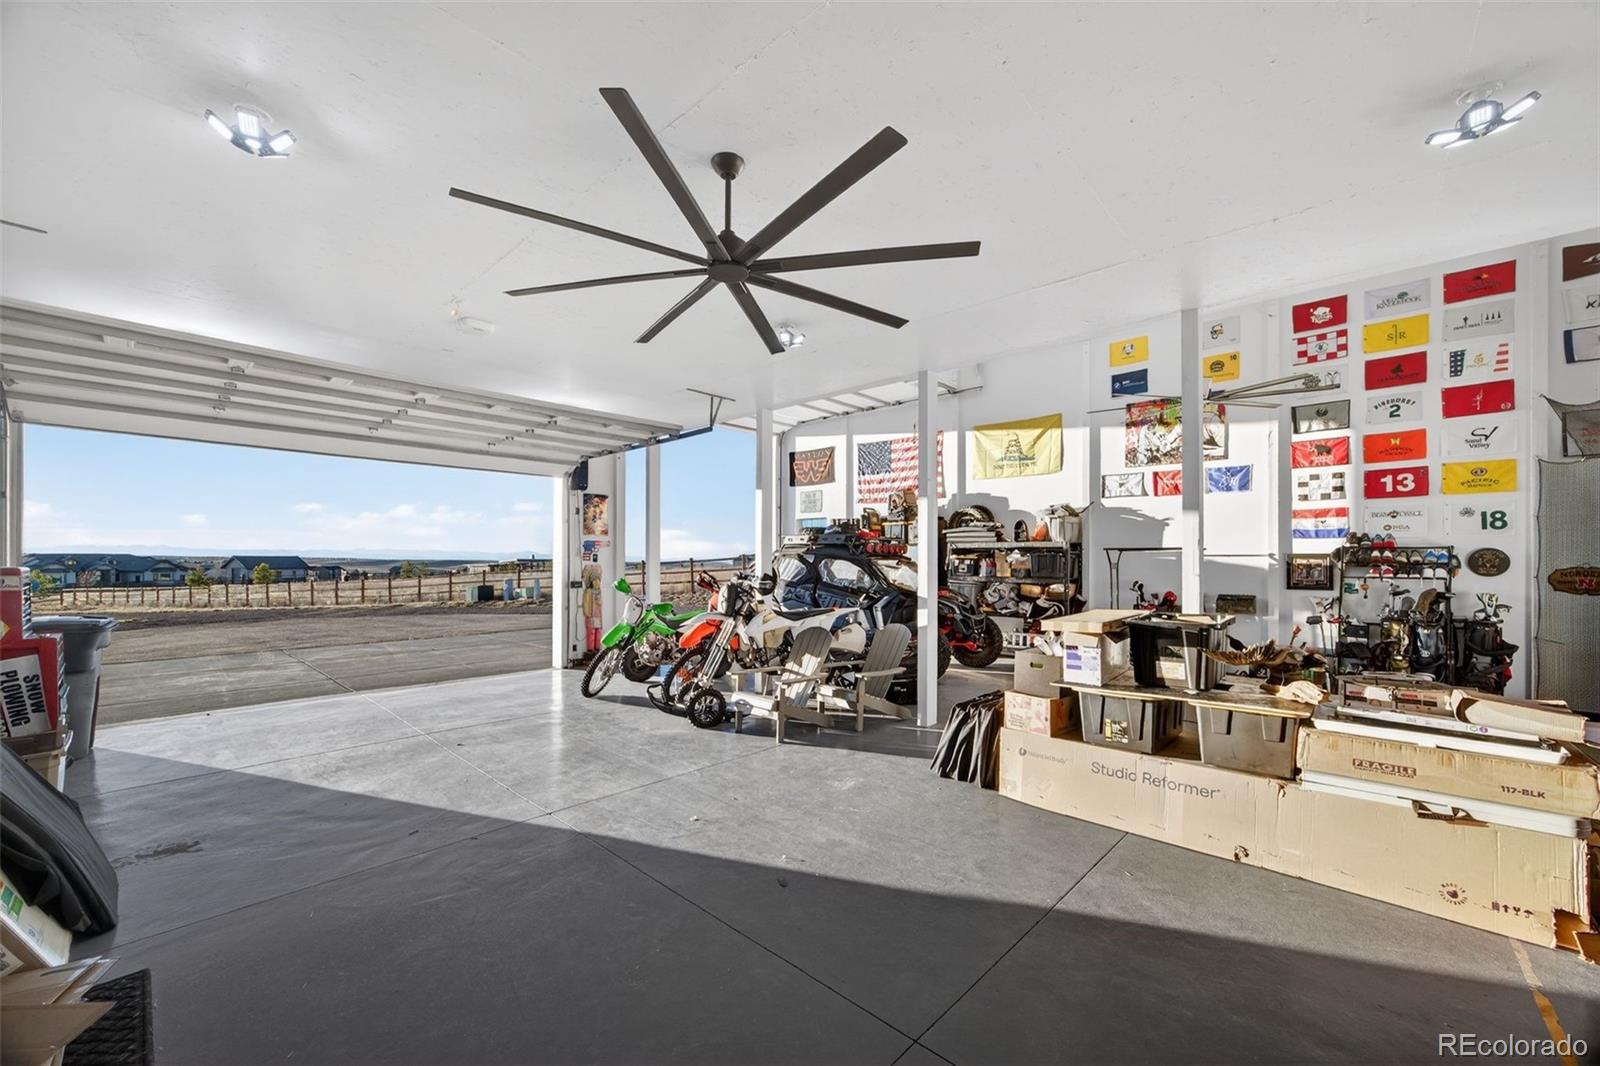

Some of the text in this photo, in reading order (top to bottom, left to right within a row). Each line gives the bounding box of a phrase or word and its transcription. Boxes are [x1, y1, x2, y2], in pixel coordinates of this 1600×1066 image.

[1388, 403, 1401, 418] 2
[1380, 472, 1415, 493] 13
[1480, 510, 1508, 530] 18
[0, 670, 31, 727] PLOWING
[23, 674, 46, 713] SNOW
[1091, 760, 1137, 783] Studio
[1354, 759, 1415, 776] FRAGILE
[1500, 785, 1546, 799] 117-BLK
